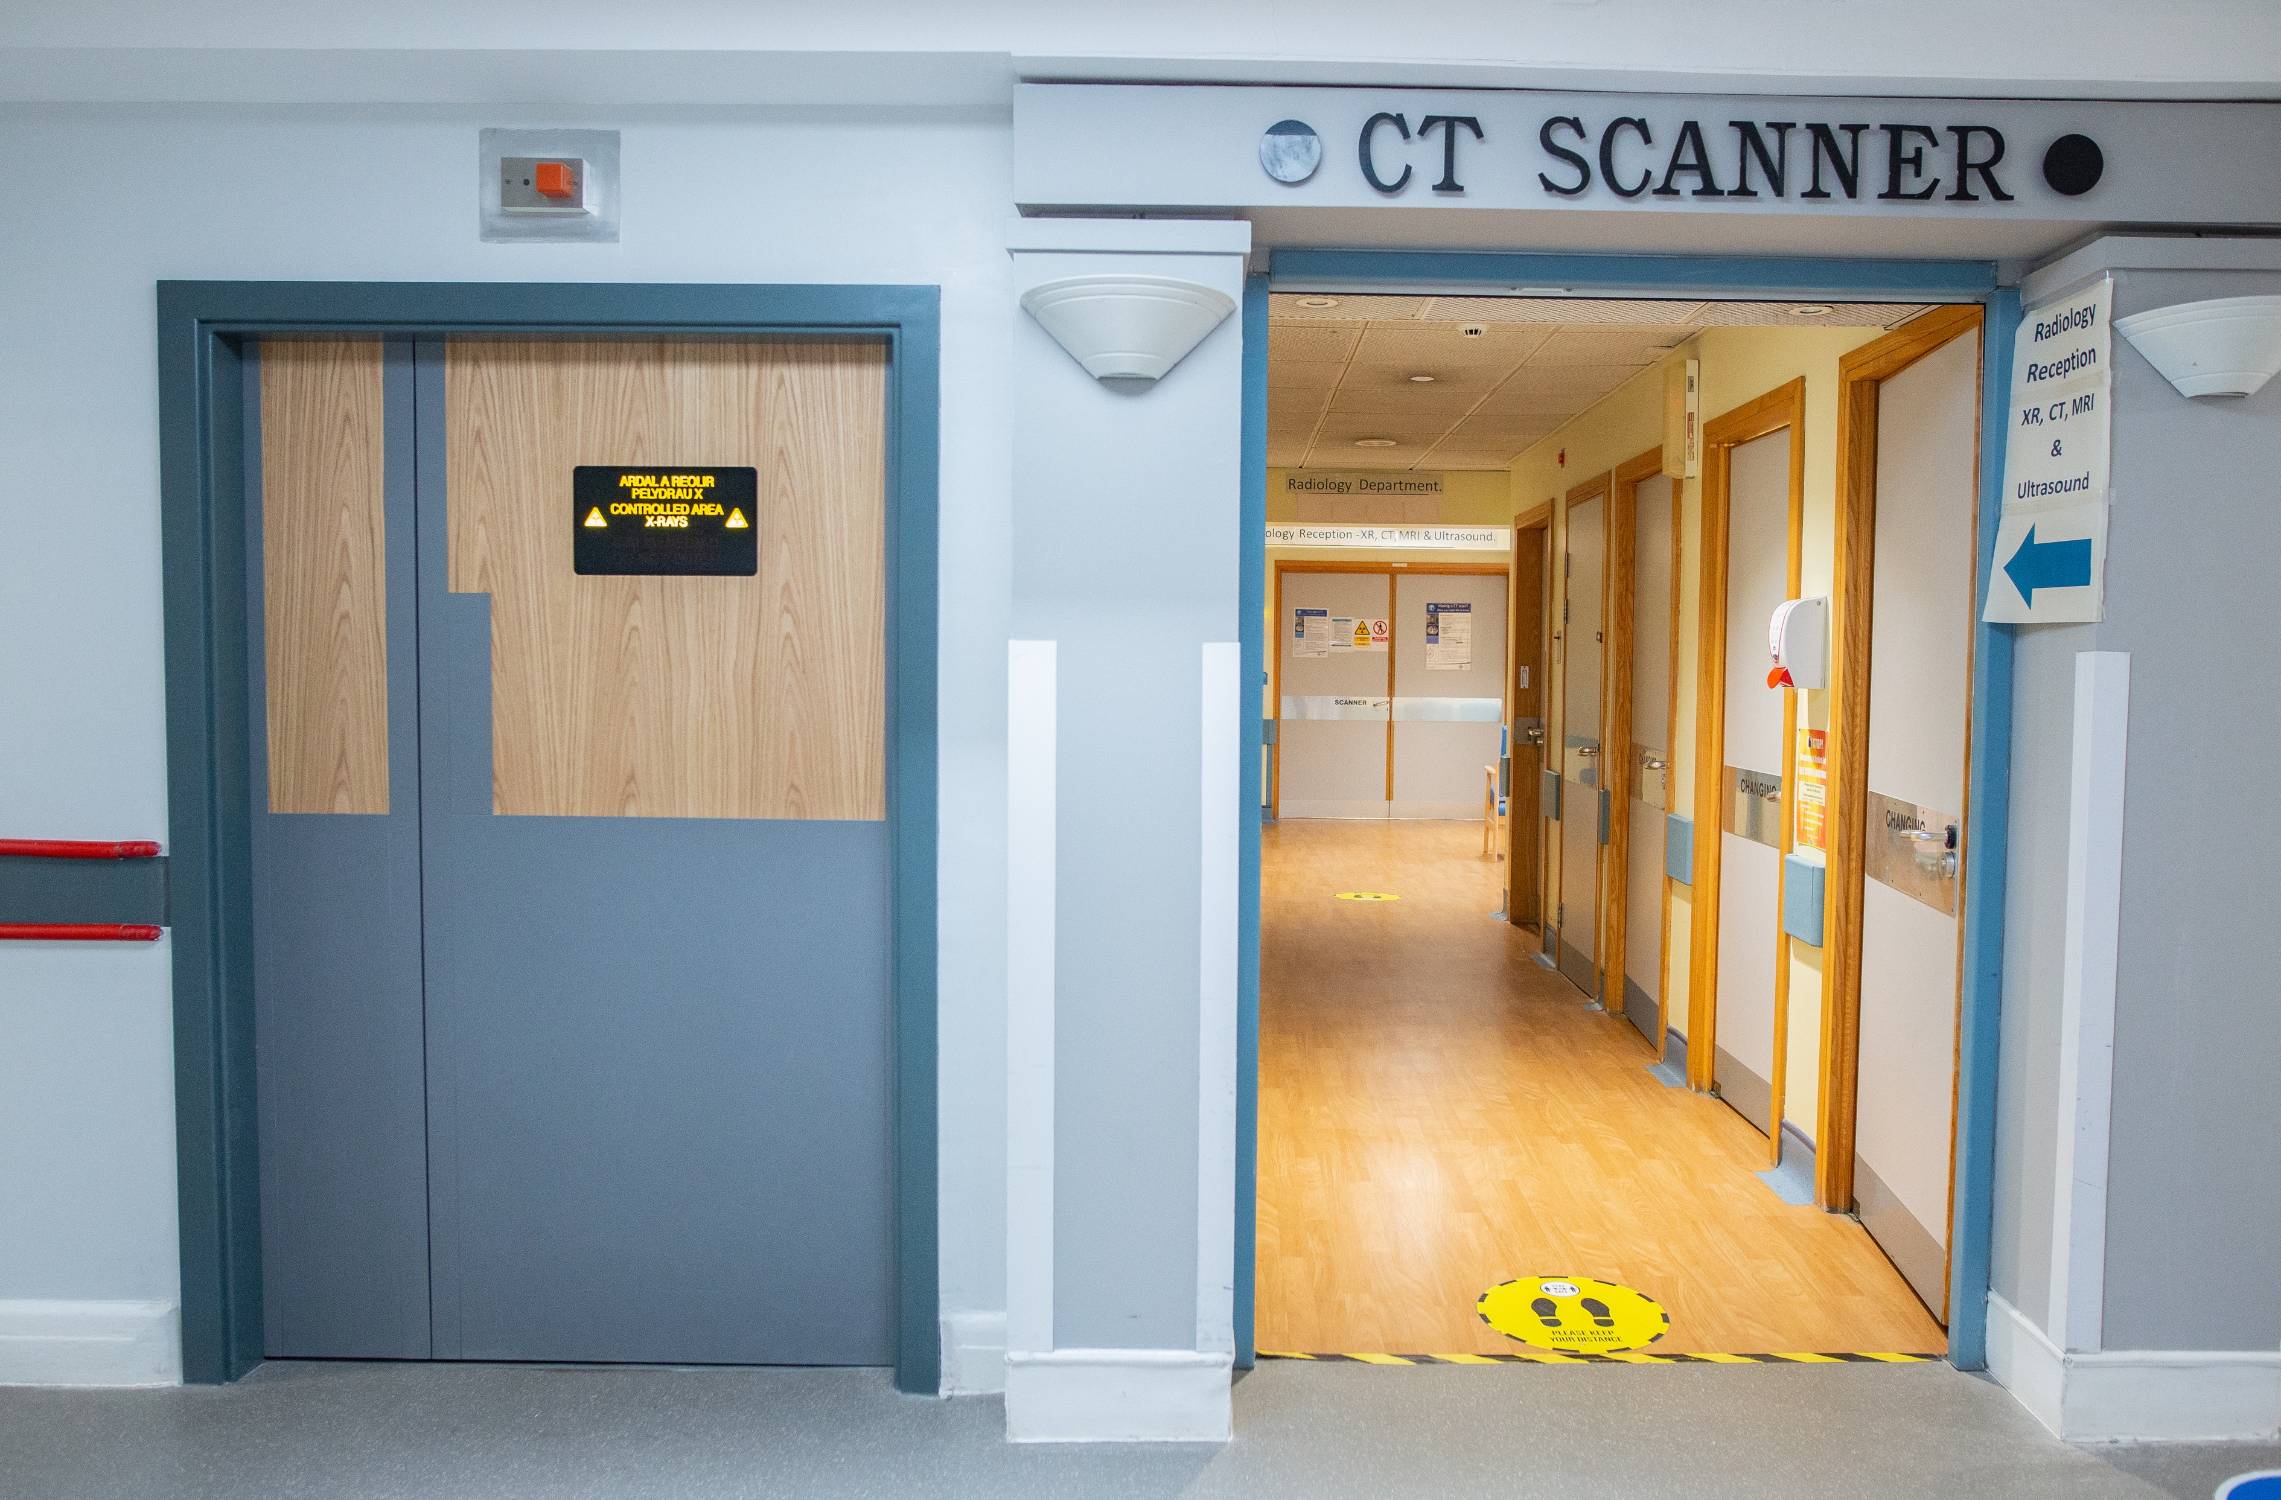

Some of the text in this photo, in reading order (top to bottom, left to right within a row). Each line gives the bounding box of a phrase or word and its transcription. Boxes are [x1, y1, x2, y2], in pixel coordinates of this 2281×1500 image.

[1358, 112, 2015, 202] CT SCANNER
[2033, 303, 2096, 343] Radiology
[2026, 346, 2096, 383] Reception
[2021, 394, 2095, 426] XR, CT, MRI
[2050, 439, 2062, 457] &
[619, 475, 715, 487] ARDAL A REOLIR
[1288, 478, 1443, 493] Radiology Department.
[2017, 471, 2090, 499] Ultrasound
[631, 487, 704, 499] PELYDRAU X
[610, 503, 725, 515] CONTROLLED AREA
[644, 516, 689, 528] X-RAYS
[1266, 529, 1295, 540] ology
[1299, 529, 1353, 540] Reception
[1399, 530, 1420, 540] MRI
[1423, 530, 1432, 541] &
